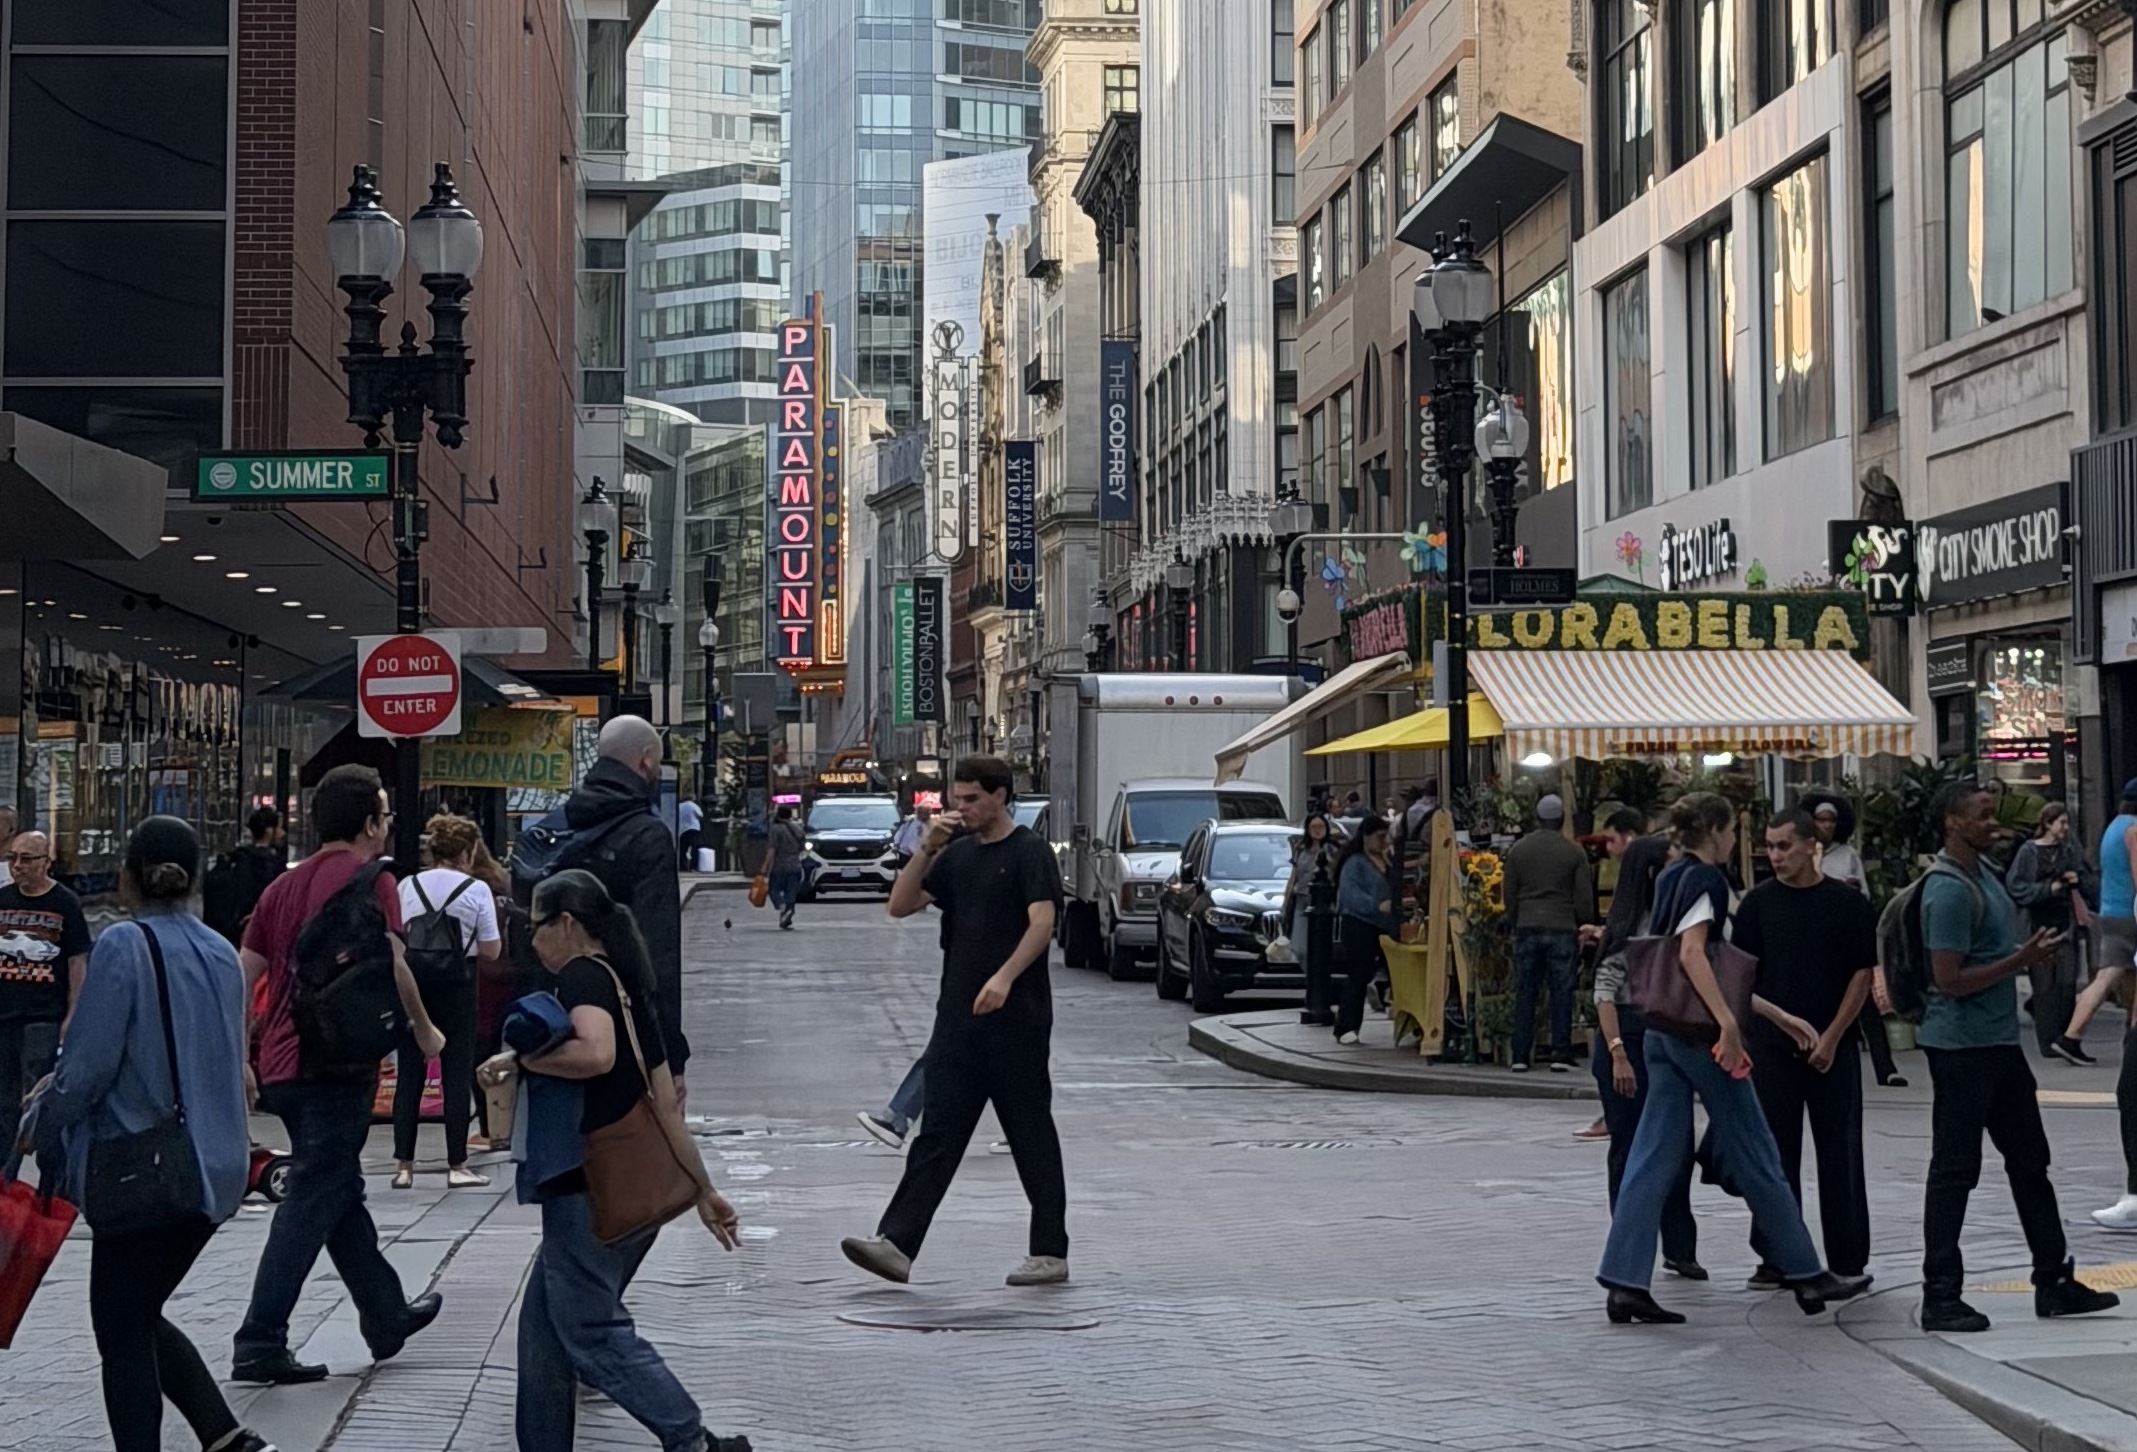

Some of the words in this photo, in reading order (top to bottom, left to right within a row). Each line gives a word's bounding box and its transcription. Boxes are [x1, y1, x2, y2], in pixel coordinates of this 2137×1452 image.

[1109, 359, 1126, 400] THE
[250, 462, 353, 490] SUMMER
[365, 473, 381, 488] ST
[940, 372, 959, 538] MODERN
[1108, 403, 1127, 501] GODFREY
[782, 327, 809, 655] PARAMOUNT
[1007, 457, 1021, 551] SUFFOLK
[1022, 457, 1033, 550] UNIVERSITY
[1939, 530, 1969, 582] CITY
[1970, 518, 2019, 577] SMOKE
[2019, 507, 2060, 565] SHOP
[1444, 599, 1858, 650] LORABELLA
[376, 658, 399, 673] DO
[408, 655, 441, 671] NOT
[383, 698, 437, 715] ENTER
